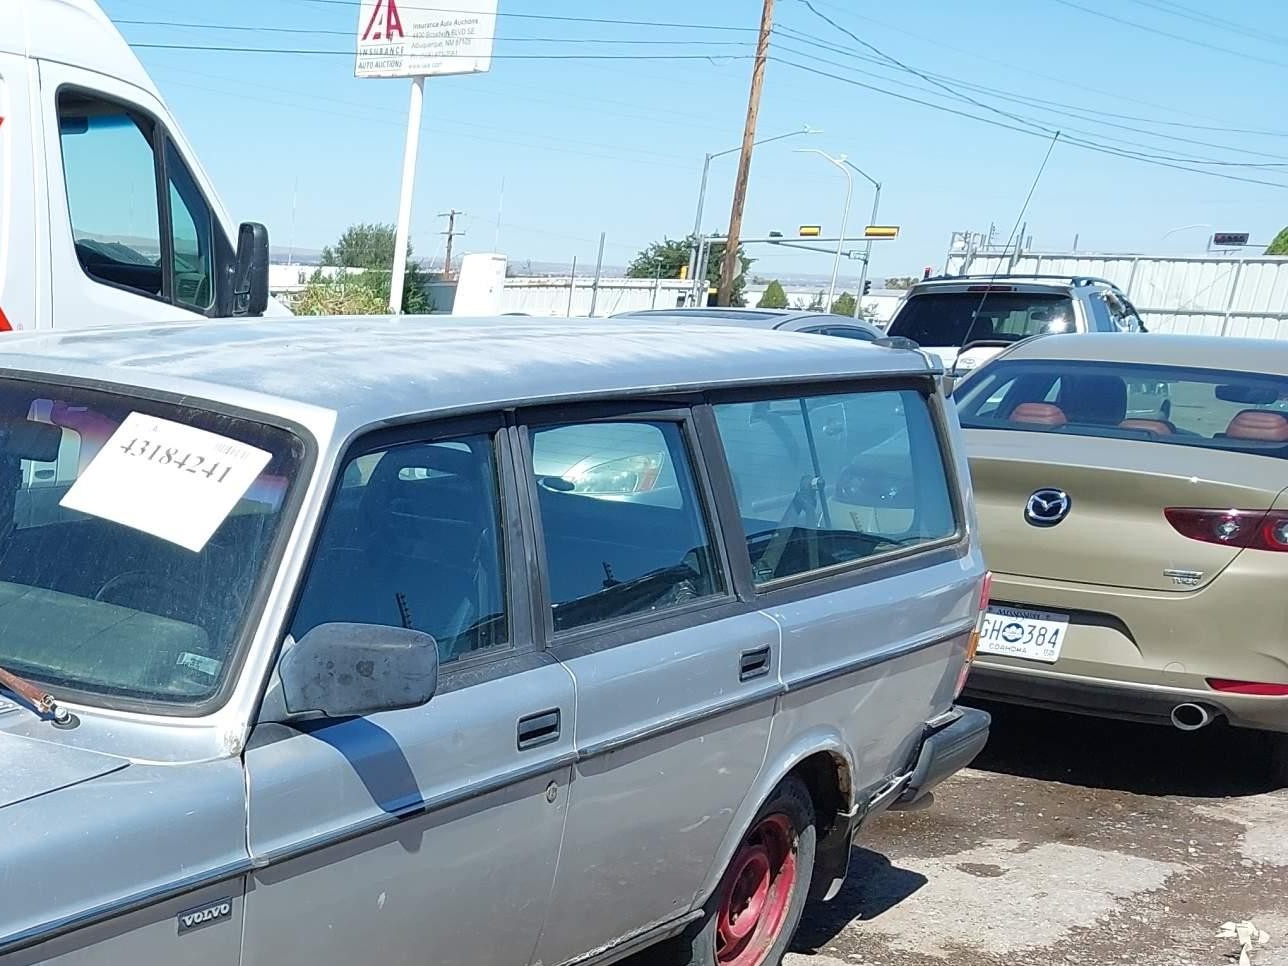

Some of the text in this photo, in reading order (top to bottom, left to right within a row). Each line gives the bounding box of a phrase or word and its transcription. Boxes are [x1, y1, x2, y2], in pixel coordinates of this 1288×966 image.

[359, 46, 405, 57] INSURANCE
[358, 60, 374, 70] AUTO
[374, 59, 403, 69] AUCTIONS
[120, 437, 233, 483] 43184241
[1023, 624, 1060, 649] 384
[182, 903, 230, 927] VOLVO
